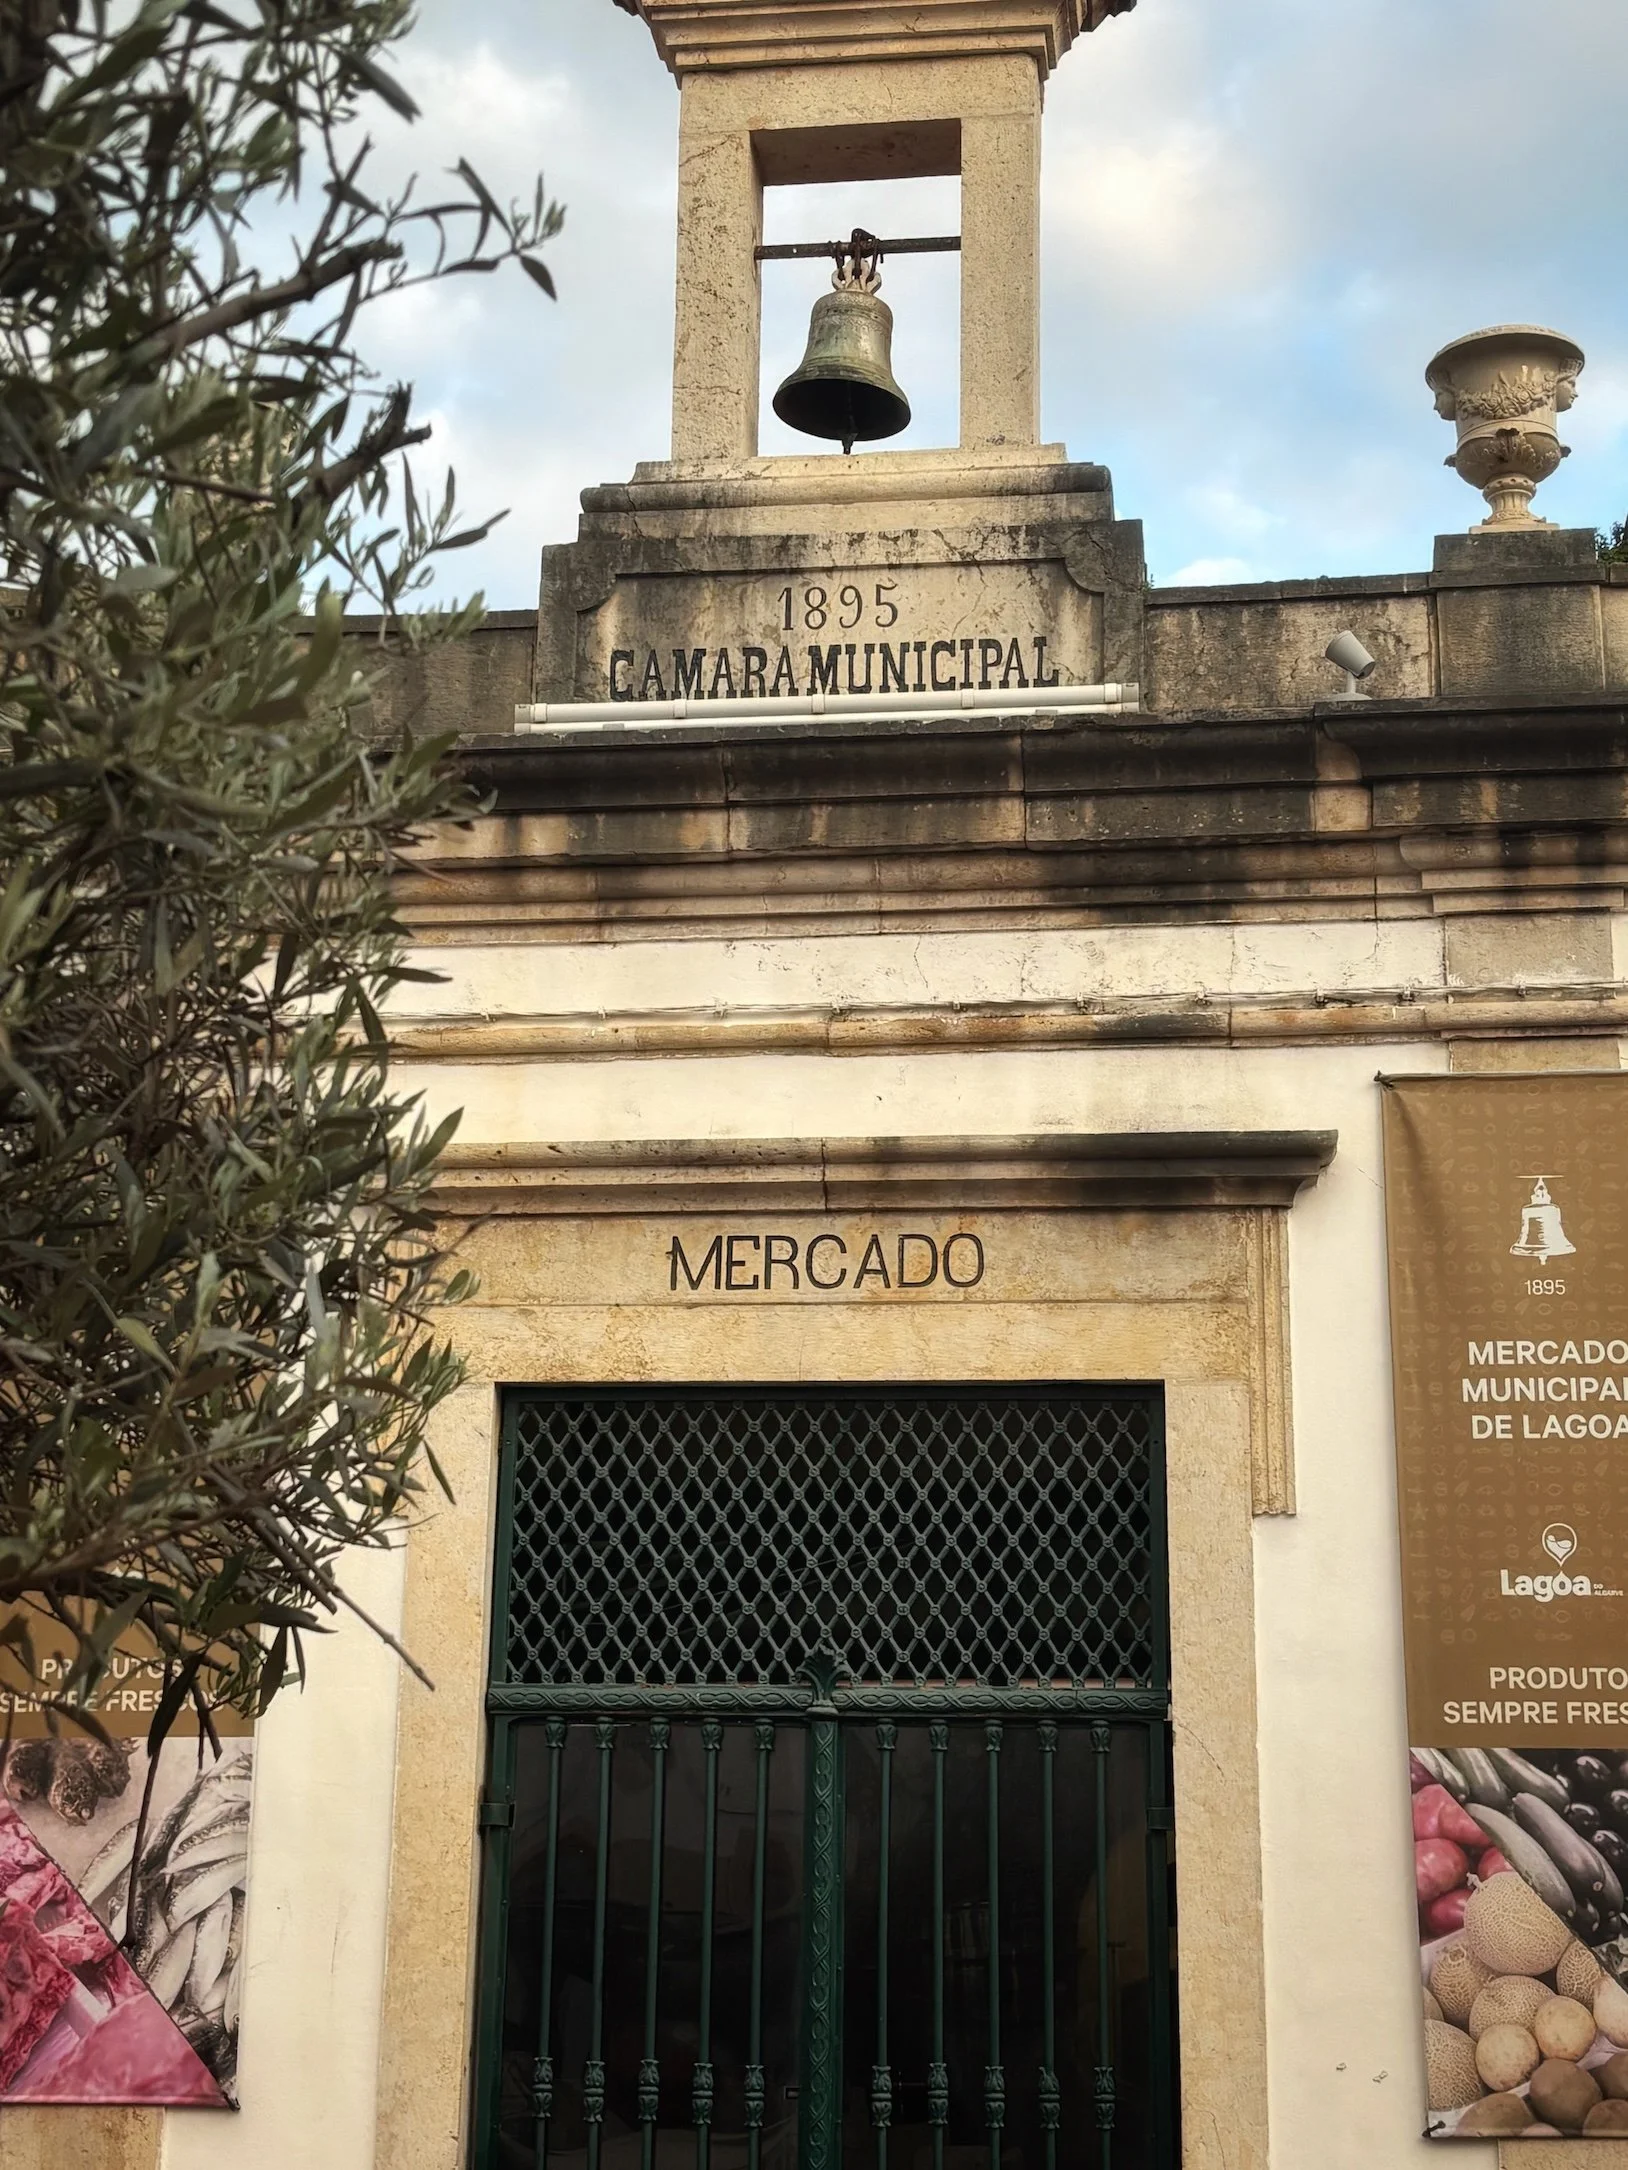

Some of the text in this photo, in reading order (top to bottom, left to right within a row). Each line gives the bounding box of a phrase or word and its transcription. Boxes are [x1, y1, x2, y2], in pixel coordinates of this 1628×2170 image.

[777, 582, 898, 630] 1895
[609, 636, 1060, 700] CAMARA MUNICIPAL
[666, 1233, 985, 1291] MERCADO
[1525, 1279, 1566, 1295] 1895
[1468, 1340, 1628, 1365] MERCADO
[1471, 1414, 1628, 1440] DE LAGOA
[1500, 1569, 1592, 1602] Lagoa
[1489, 1667, 1628, 1690] PRODUTO
[1443, 1701, 1558, 1724] SEMPRE
